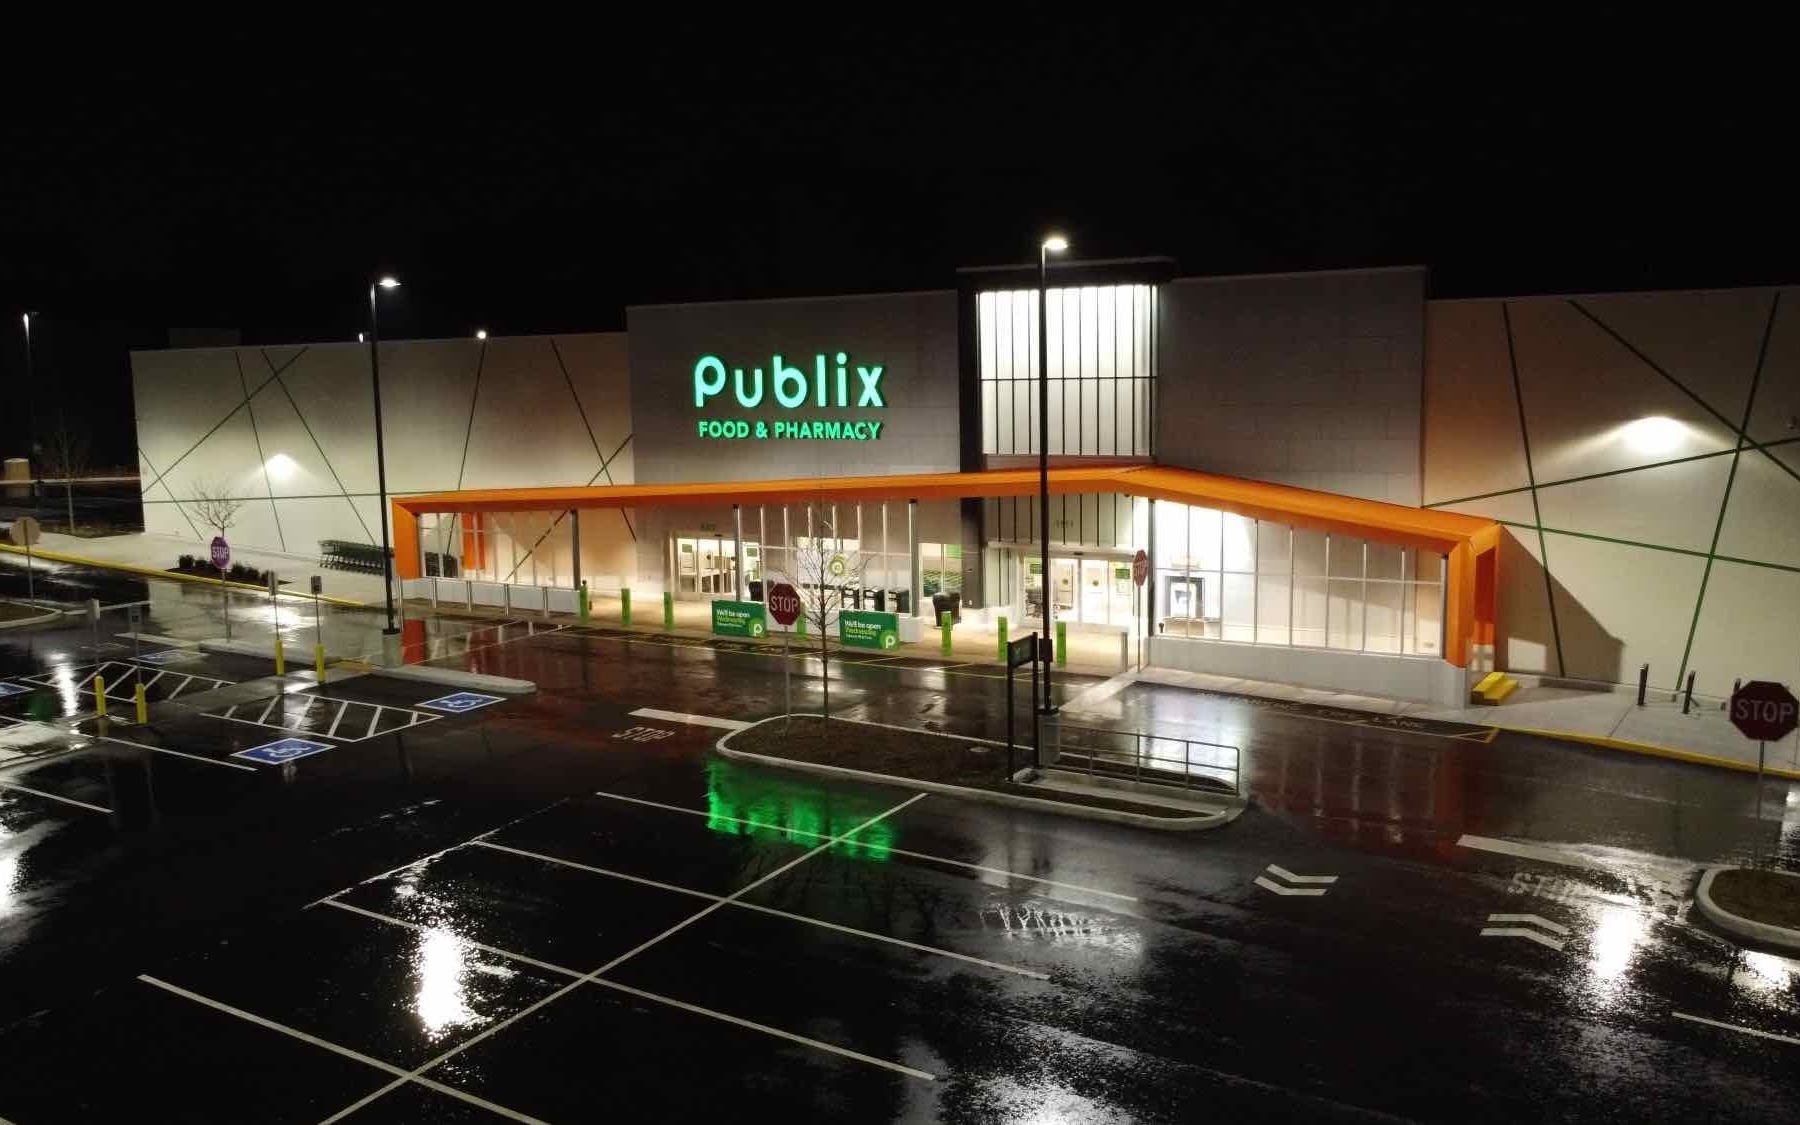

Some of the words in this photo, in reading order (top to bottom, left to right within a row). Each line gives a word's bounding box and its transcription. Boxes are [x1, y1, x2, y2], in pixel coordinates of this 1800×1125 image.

[693, 351, 884, 408] Publix
[698, 420, 750, 439] FOOD
[755, 421, 768, 439] &
[774, 421, 882, 440] PHARMACY
[212, 546, 229, 559] STOP
[770, 595, 798, 613] STOP
[1735, 699, 1795, 723] STOP
[611, 726, 676, 742] STOP
